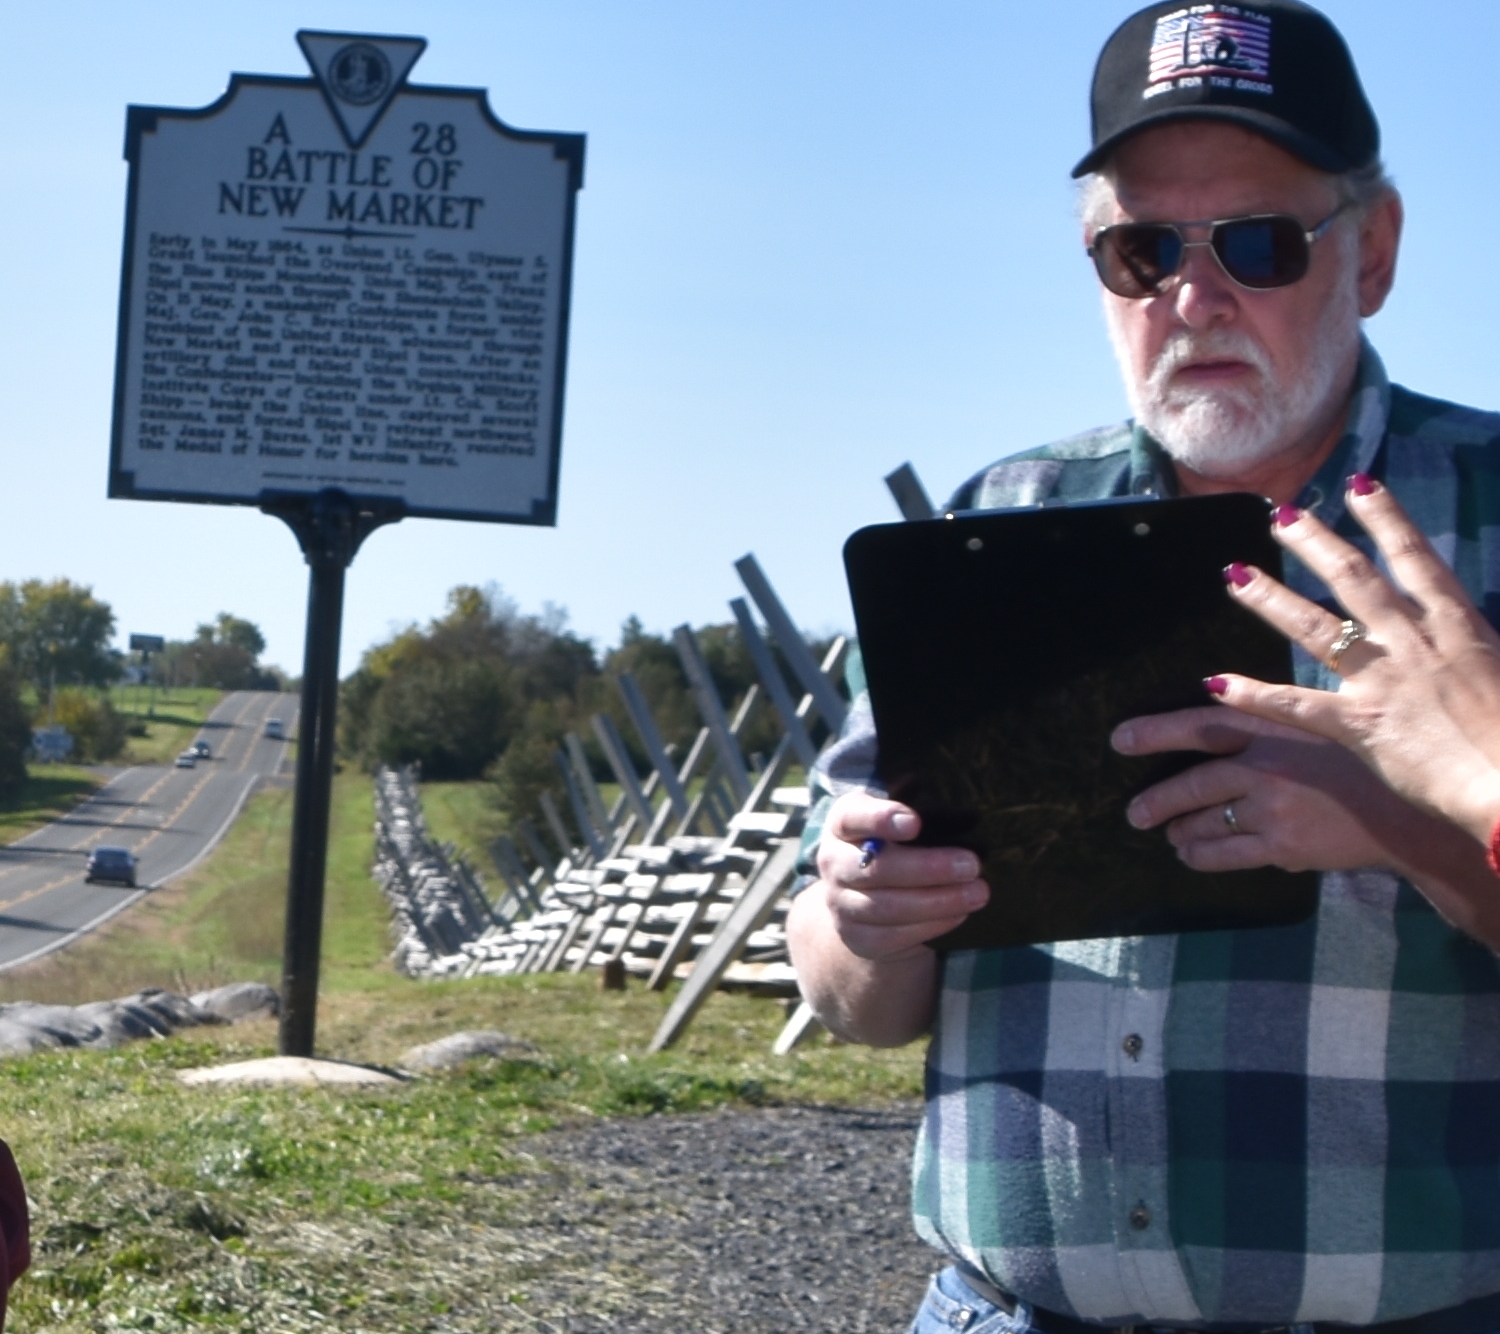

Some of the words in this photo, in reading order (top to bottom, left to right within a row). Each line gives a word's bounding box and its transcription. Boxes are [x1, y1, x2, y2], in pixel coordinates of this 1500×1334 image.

[1220, 4, 1239, 15] THE
[1177, 76, 1203, 87] FOR
[1210, 76, 1232, 87] THE
[264, 112, 291, 145] A
[412, 123, 457, 155] 28
[246, 146, 392, 188] BATTLE
[412, 159, 463, 192] OF
[218, 181, 304, 218] NEW
[326, 190, 485, 230] MARKET
[148, 247, 193, 260] Grant
[205, 251, 274, 265] launched
[285, 256, 310, 267] the
[321, 259, 392, 273] Overland
[402, 264, 477, 280] Campaign
[487, 270, 518, 281] east
[531, 271, 546, 282] of
[149, 233, 190, 250] Early
[201, 236, 216, 248] in
[226, 237, 258, 254] May
[317, 245, 332, 255] as
[342, 246, 384, 257] Union
[394, 247, 414, 260] Lt.
[423, 249, 458, 262] Gen.
[467, 251, 523, 268] Ulysses
[147, 277, 181, 291] Sigel
[189, 281, 235, 292] moved
[244, 283, 283, 295] south
[292, 286, 351, 300] through
[361, 290, 384, 301] the
[395, 292, 485, 307] Shenandoah
[495, 299, 543, 313] Valley.
[148, 263, 172, 274] the
[182, 264, 213, 276] Blue
[224, 267, 265, 281] Ridge
[276, 271, 354, 285] Mountains,
[365, 277, 405, 288] Union
[416, 279, 444, 293] Maj.
[458, 278, 490, 293] Gen.
[145, 291, 167, 302] On
[200, 295, 235, 309] May,
[263, 299, 335, 313] makeshift
[347, 304, 437, 319] Confederate
[448, 310, 486, 322] force
[499, 315, 543, 325] under
[145, 306, 178, 320] Maj.
[190, 308, 225, 320] Gen.
[237, 310, 273, 323] John
[312, 317, 416, 332] Breckinridge,
[446, 325, 497, 336] former
[511, 329, 543, 339] vice
[144, 335, 174, 346] New
[186, 337, 240, 350] Market
[252, 341, 280, 353] and
[291, 344, 360, 357] attacked
[371, 348, 407, 362] Sigel
[418, 352, 456, 363] here.
[469, 354, 510, 366] After
[522, 360, 540, 369] an
[145, 321, 214, 335] president
[224, 325, 239, 336] of
[248, 327, 272, 338] the
[281, 329, 330, 341] United
[341, 332, 389, 344] States,
[401, 337, 471, 350] advanced
[483, 341, 542, 355] through
[142, 350, 210, 366] artillery
[267, 358, 296, 369] and
[308, 360, 351, 372] failed
[364, 364, 406, 375] Union
[417, 368, 540, 383] counterattacks,
[143, 364, 166, 375] the
[371, 378, 395, 389] the
[405, 380, 462, 394] Virginia
[473, 385, 538, 400] Military
[141, 379, 208, 393] Institute
[220, 383, 265, 397] Corps
[275, 386, 291, 398] of
[304, 388, 357, 401] Cadets
[368, 394, 412, 405] under
[424, 395, 443, 407] Lt.
[455, 396, 483, 409] Col.
[496, 397, 538, 412] Scott
[139, 409, 206, 422] cannons,
[215, 412, 244, 424] and
[254, 414, 304, 428] forced
[314, 418, 351, 432] Sigel
[361, 422, 377, 432] to
[386, 424, 442, 436] retreat
[262, 400, 287, 412] the
[299, 403, 342, 415] Union
[355, 406, 389, 419] line,
[399, 410, 469, 423] captured
[481, 416, 537, 427] several
[138, 438, 163, 450] the
[174, 439, 222, 453] Medal
[230, 442, 248, 455] of
[258, 444, 305, 457] Honor
[314, 447, 339, 459] for
[348, 450, 408, 464] heroism
[418, 454, 459, 467] here.
[139, 422, 169, 437] Sgt.
[179, 427, 225, 438] James
[235, 428, 252, 440] M.
[262, 429, 311, 443] Burns,
[323, 434, 341, 444] 1st
[351, 434, 375, 445] WV
[385, 438, 456, 453] Infantry,
[466, 443, 535, 456] received
